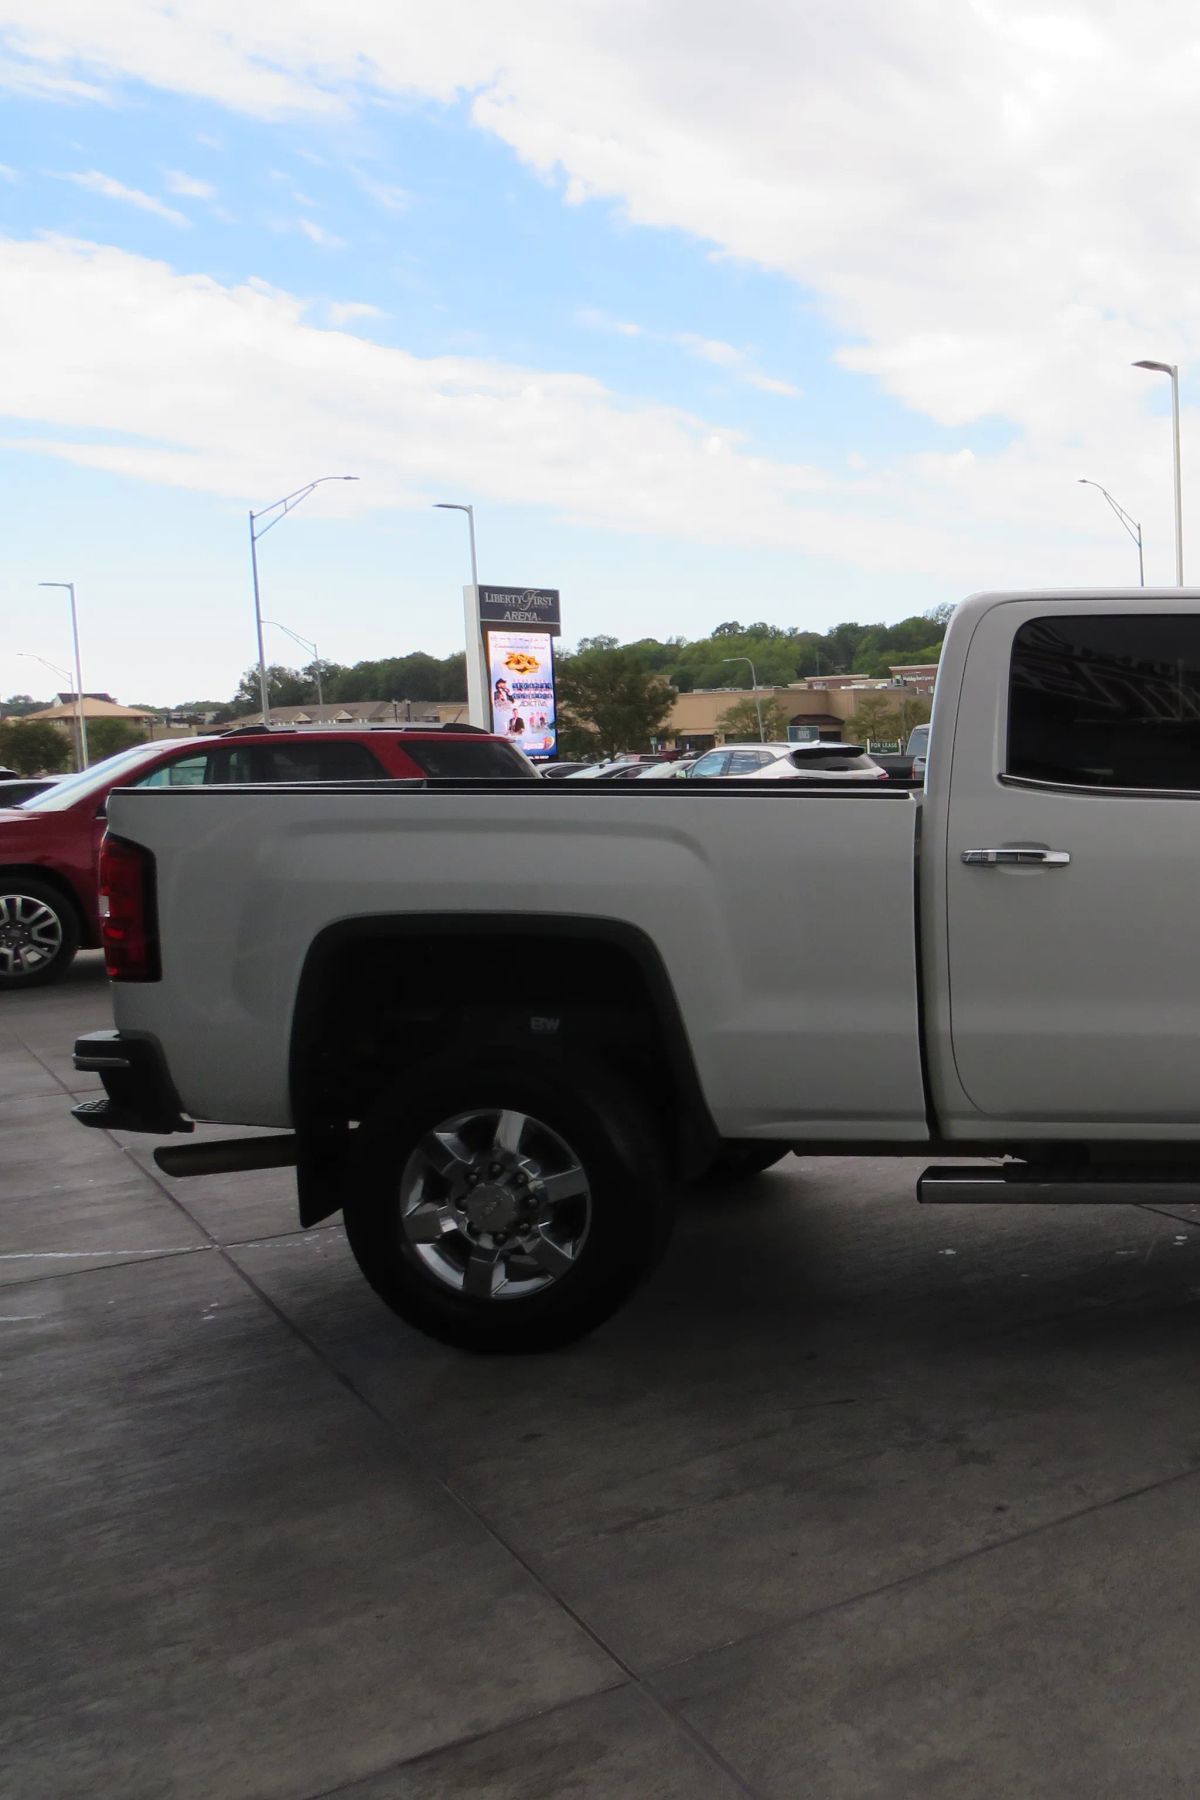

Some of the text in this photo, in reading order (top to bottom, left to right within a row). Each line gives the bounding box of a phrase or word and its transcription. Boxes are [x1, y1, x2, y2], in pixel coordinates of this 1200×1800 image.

[485, 590, 554, 610] LIBERTY FIRST
[504, 611, 538, 621] ARENA
